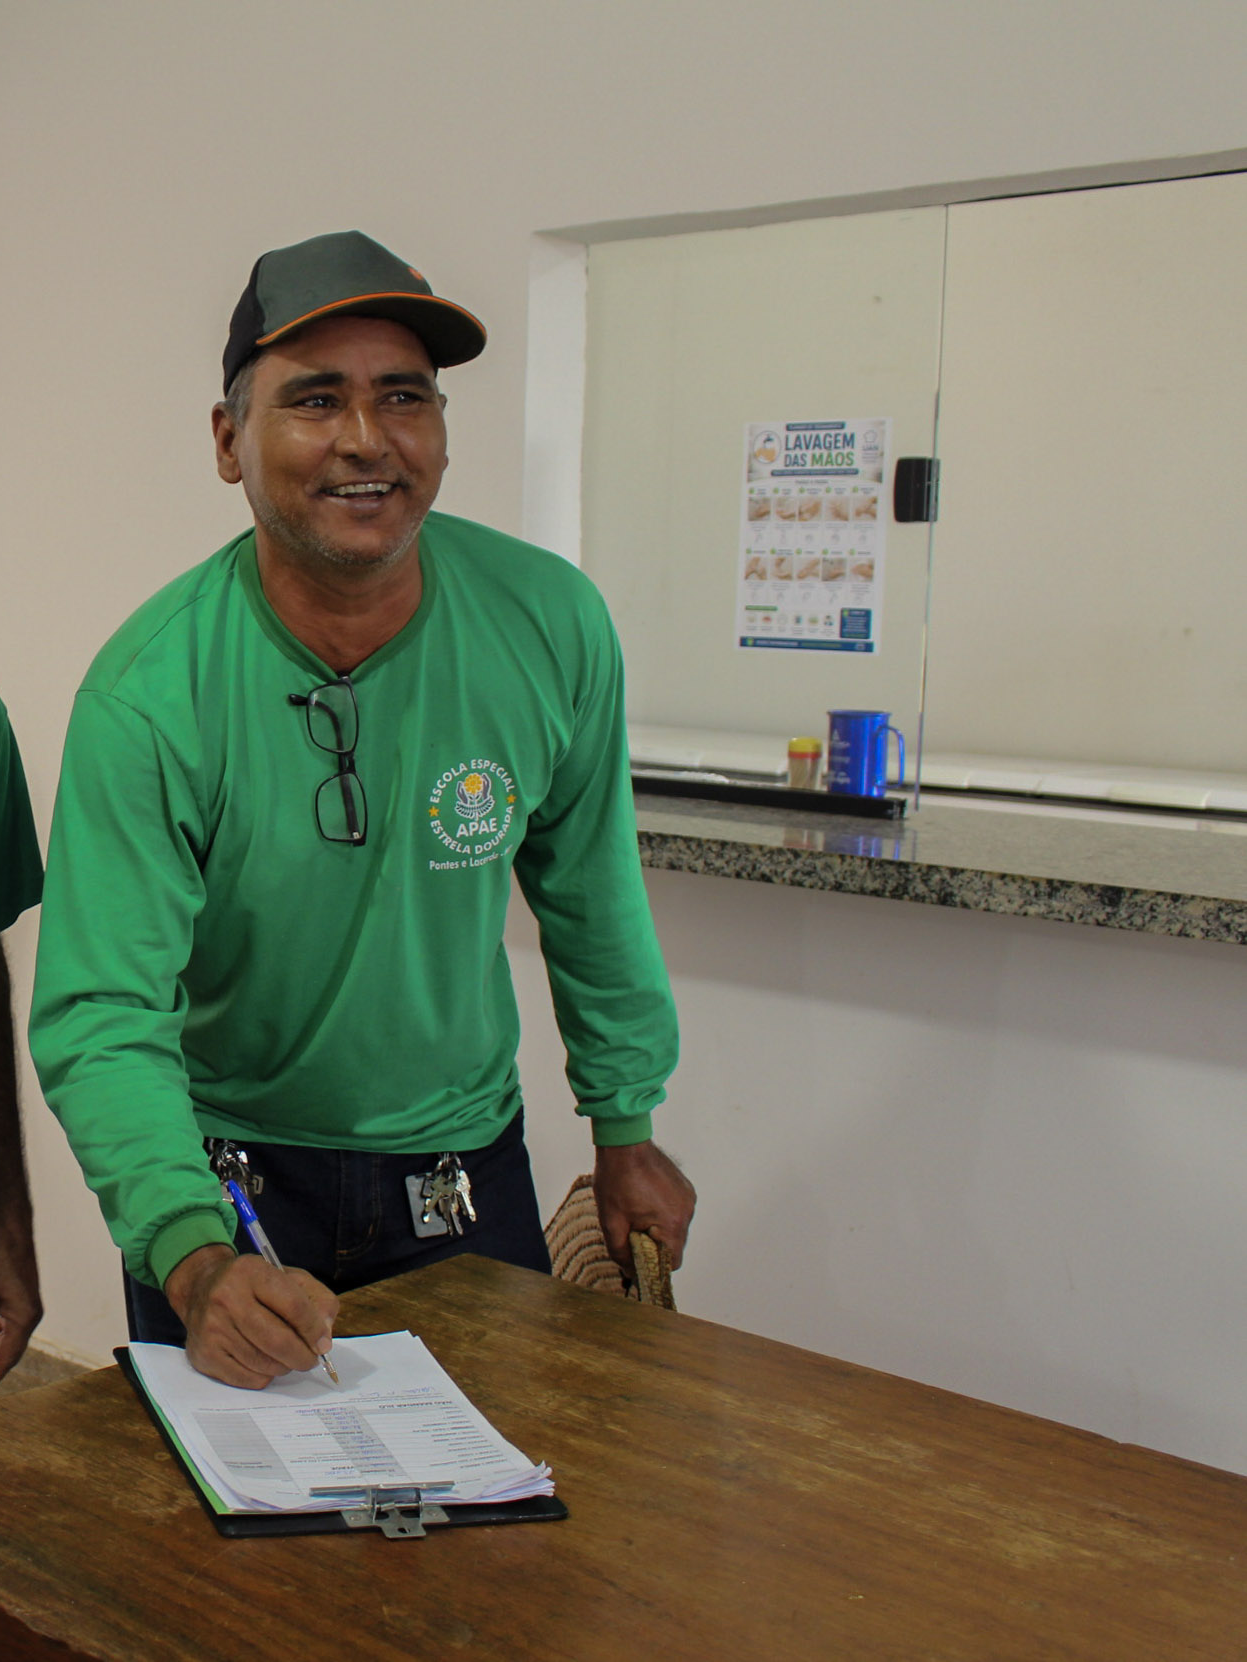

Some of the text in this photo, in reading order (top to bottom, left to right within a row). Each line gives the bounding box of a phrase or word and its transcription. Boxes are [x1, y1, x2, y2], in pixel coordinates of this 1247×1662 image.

[785, 432, 855, 451] LAVAGEM
[784, 453, 807, 467] DAS
[811, 450, 854, 467] MÃOS
[430, 759, 515, 804] ESCOLA ESPECIAL
[430, 805, 514, 854] ESTRELA DOURADA
[456, 818, 498, 838] APAE
[429, 860, 459, 870] Pontes
[461, 860, 467, 868] e
